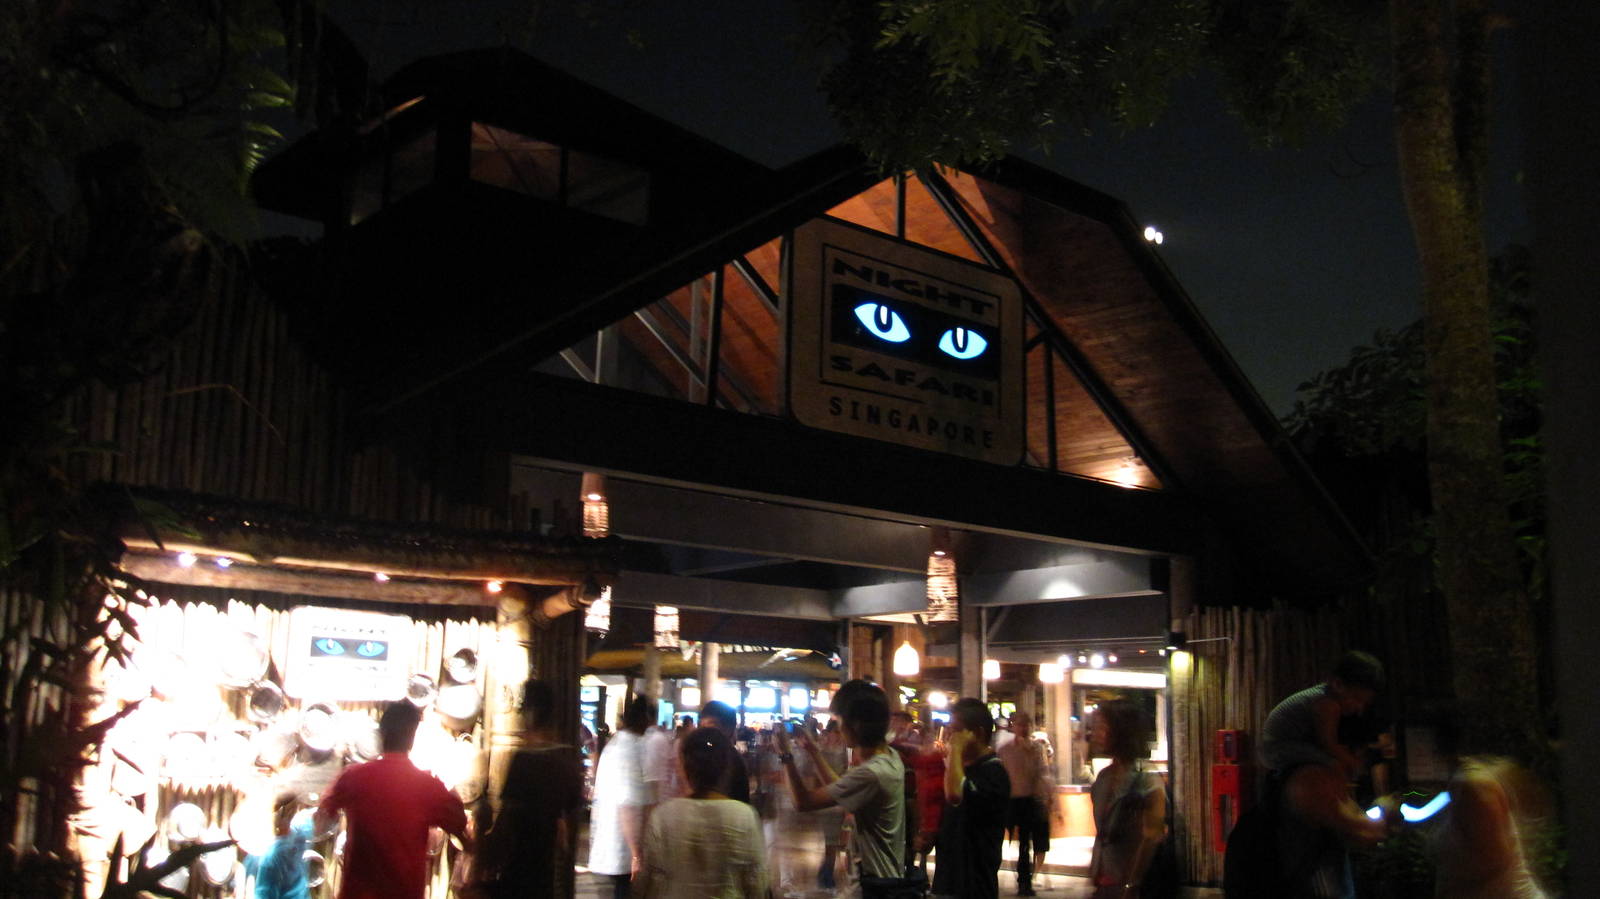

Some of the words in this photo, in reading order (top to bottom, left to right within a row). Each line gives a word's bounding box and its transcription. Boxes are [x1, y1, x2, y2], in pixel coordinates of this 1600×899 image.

[833, 258, 993, 315] NIGHT
[830, 355, 993, 406] SAFARI
[829, 396, 993, 449] SINGAPORE
